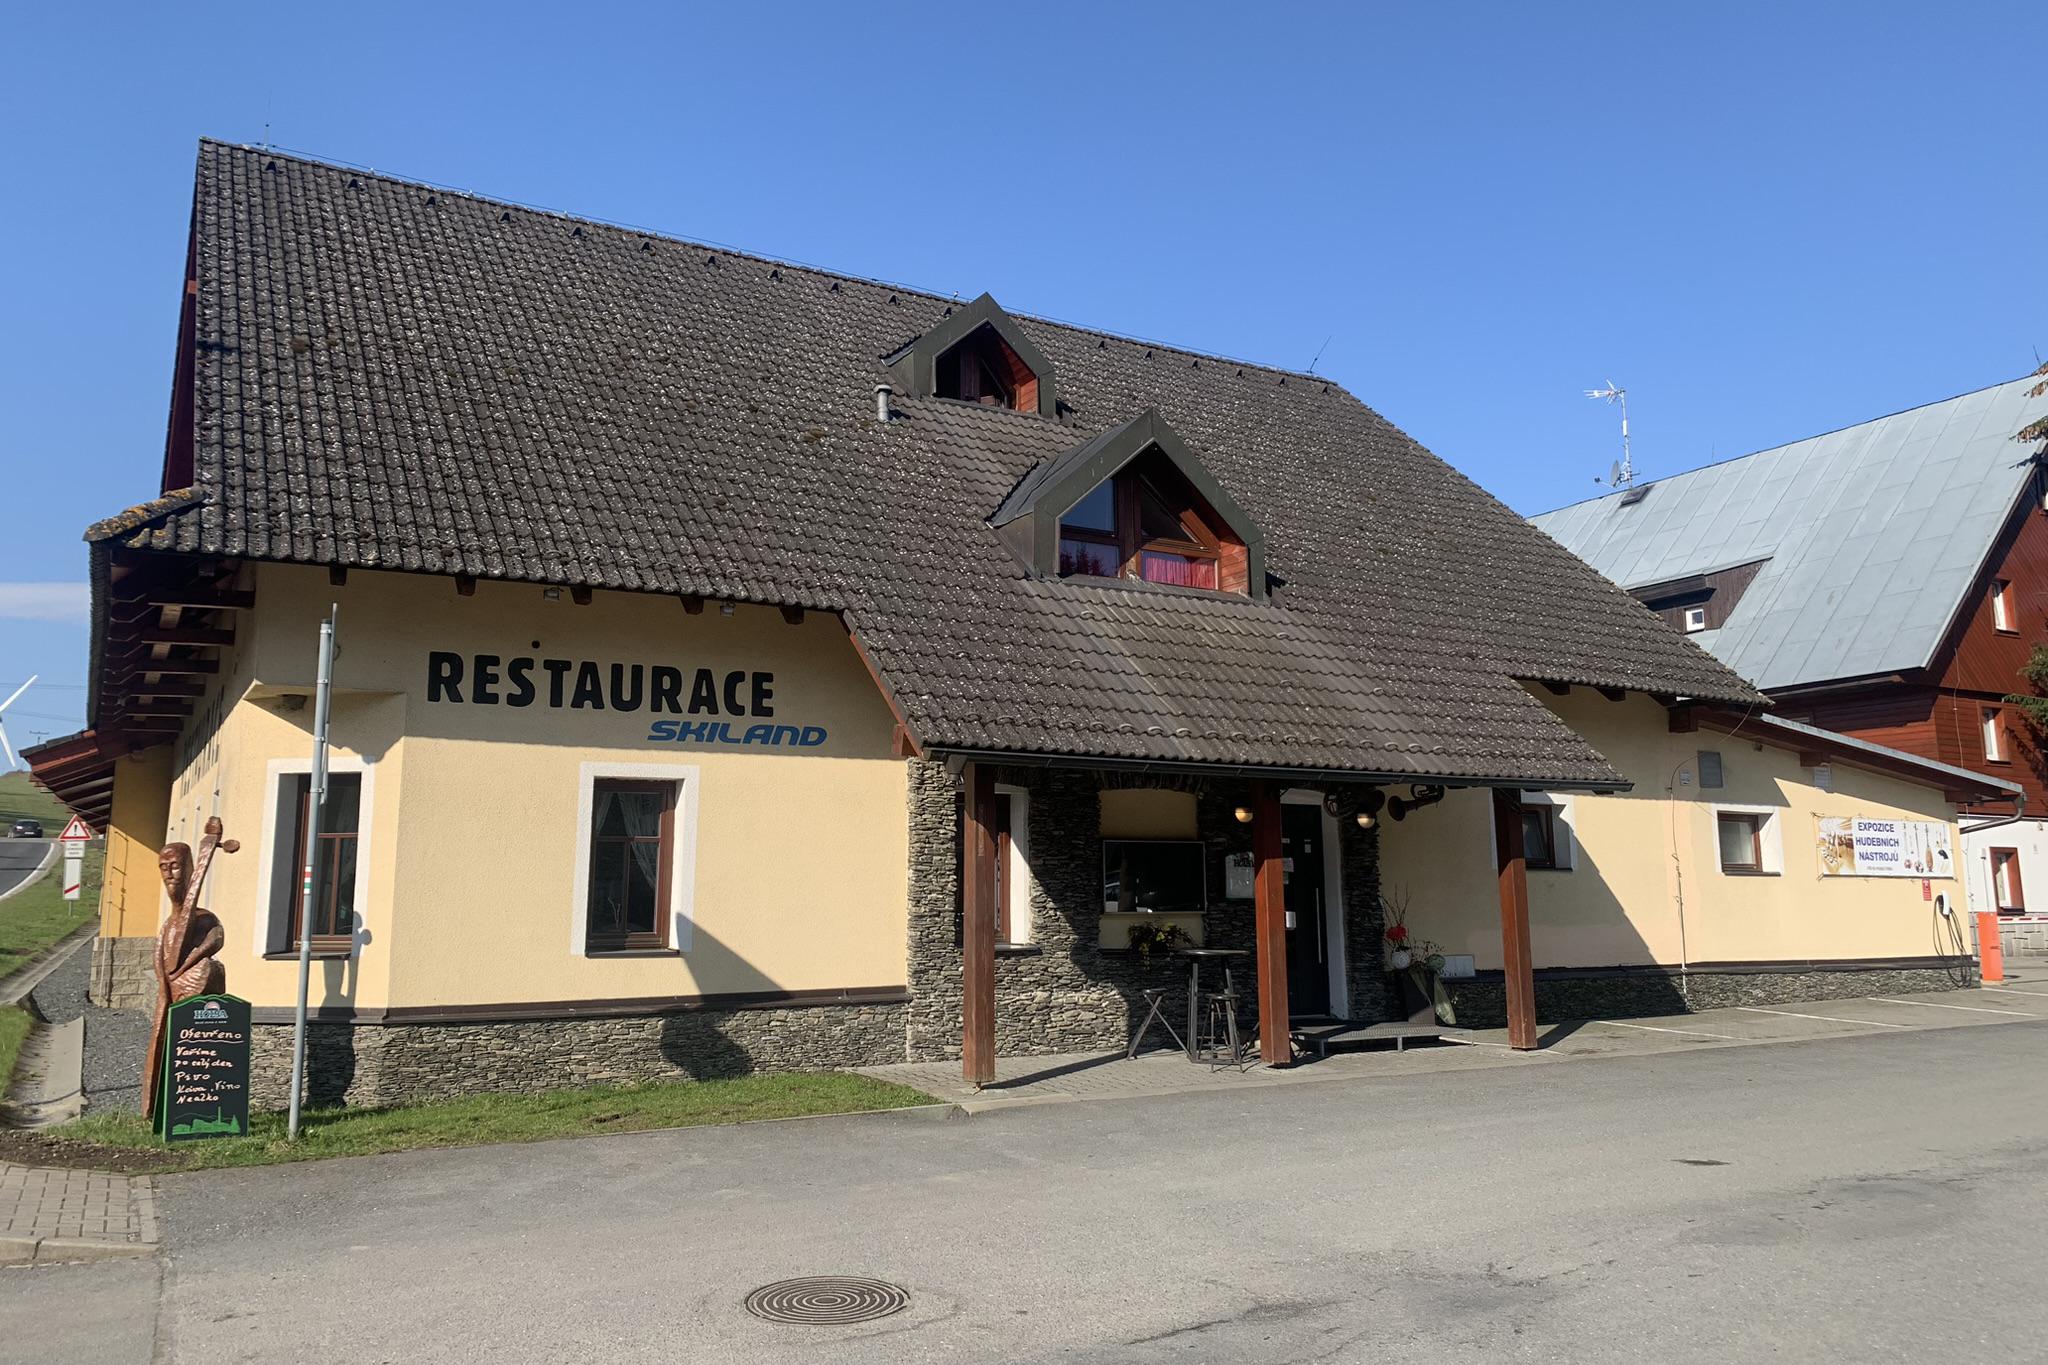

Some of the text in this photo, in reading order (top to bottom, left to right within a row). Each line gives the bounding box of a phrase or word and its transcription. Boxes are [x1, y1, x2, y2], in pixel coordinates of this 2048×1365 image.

[427, 651, 775, 718] RESTAURACE
[647, 720, 828, 747] SKILAND
[1858, 822, 1895, 832] EXPOZICE
[180, 1028, 242, 1039] Otevřeno
[211, 1059, 233, 1067] den
